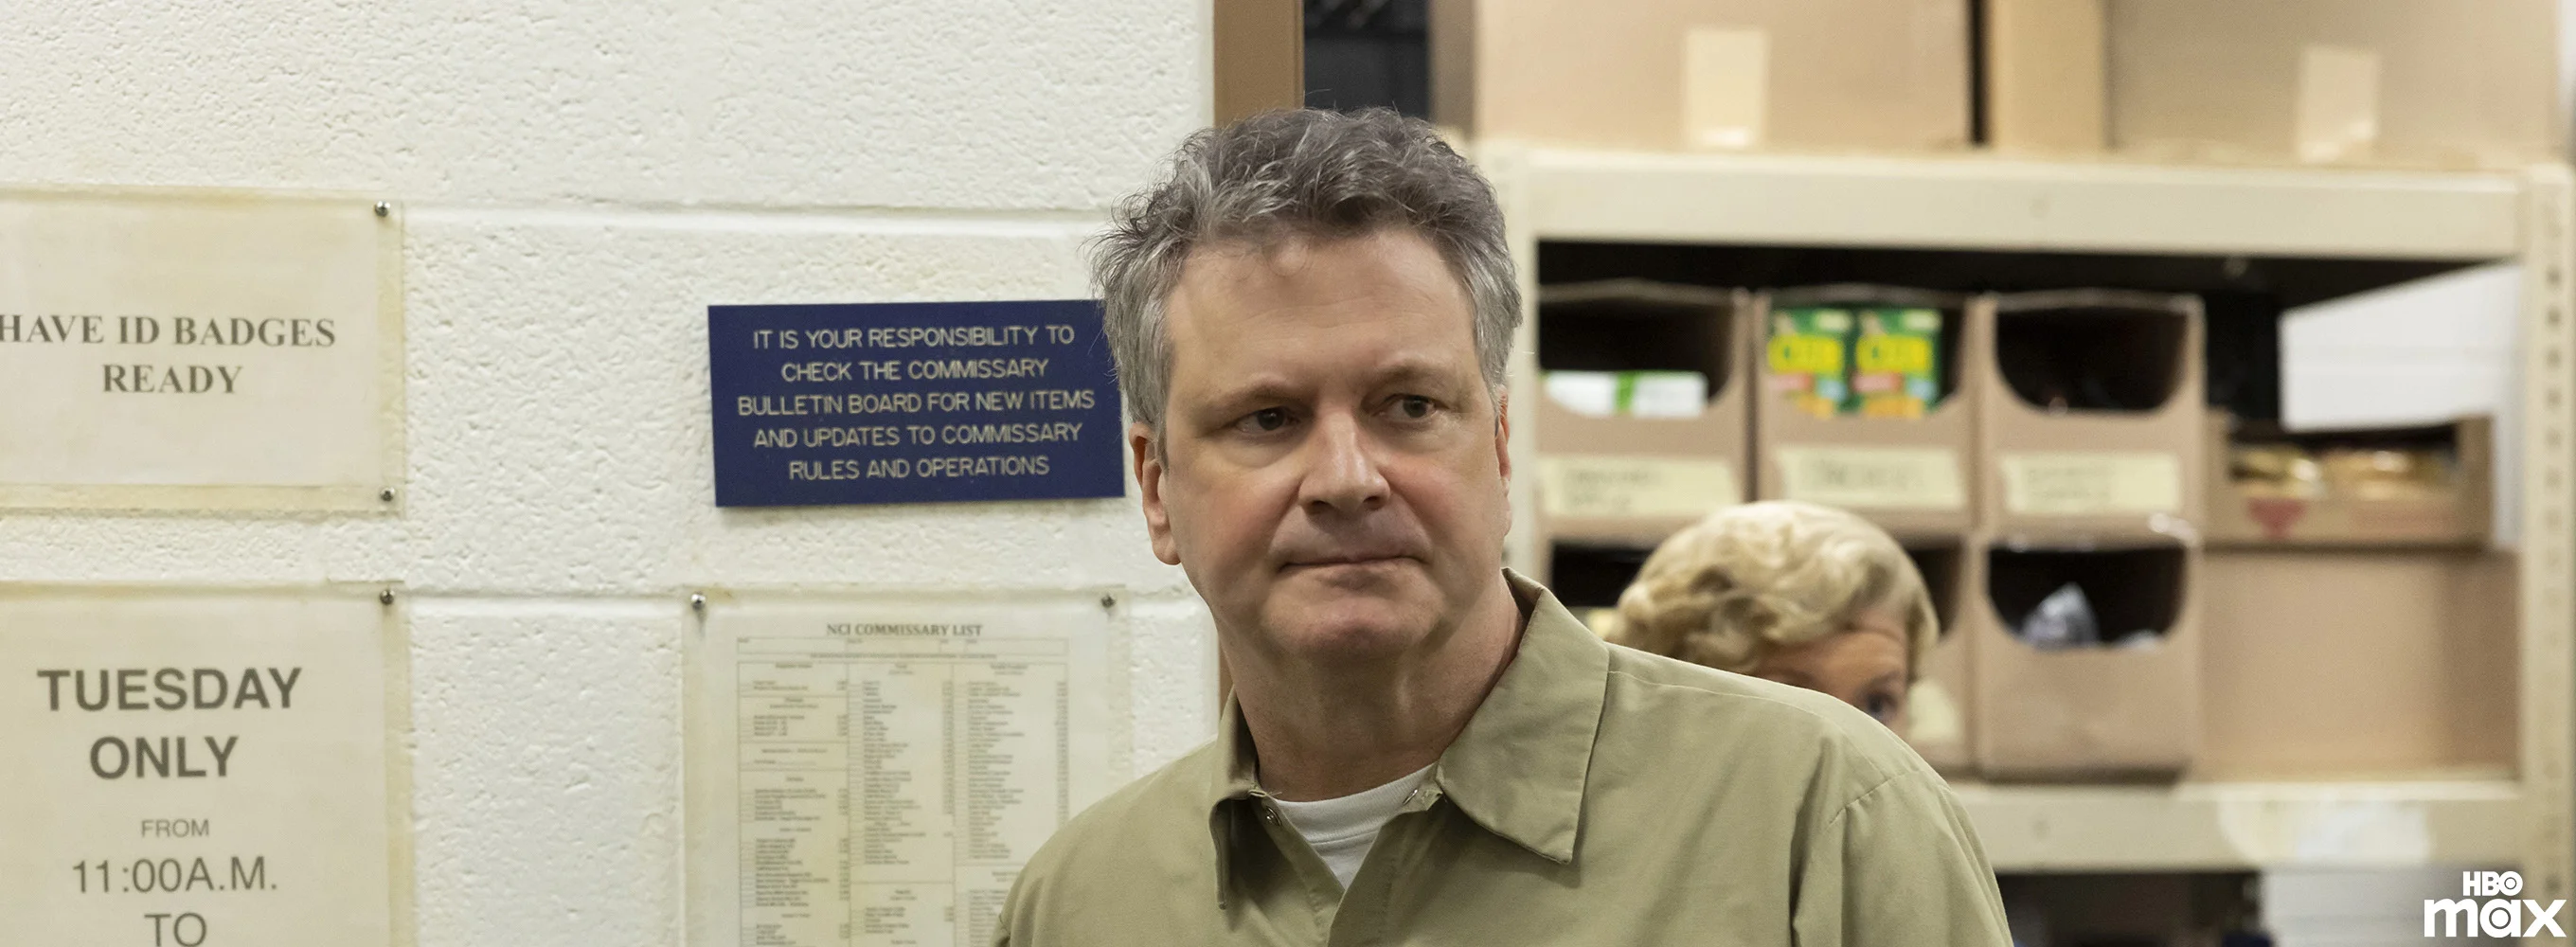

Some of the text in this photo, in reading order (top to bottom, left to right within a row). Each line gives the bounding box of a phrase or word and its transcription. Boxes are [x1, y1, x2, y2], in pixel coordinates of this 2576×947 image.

[0, 314, 336, 348] HAVE ID BADGES
[754, 325, 1075, 349] IT IS YOUR RESPONSIBILITY TO
[102, 364, 243, 394] READY
[781, 358, 1049, 382] CHECK THE COMMISSARY
[737, 389, 1096, 417] BULLETIN BOARD FOR NEW ITEMS
[754, 422, 1082, 449] AND UPDATES TO COMMISSARY
[789, 455, 1050, 481] RULES AND OPERATIONS
[827, 623, 983, 636] NCI COMMISSARY LIST
[37, 667, 302, 711] TUESDAY
[90, 735, 239, 779] ONLY
[141, 819, 210, 838] FROM
[72, 856, 278, 893] 11:00A.M.
[144, 912, 207, 947] TO
